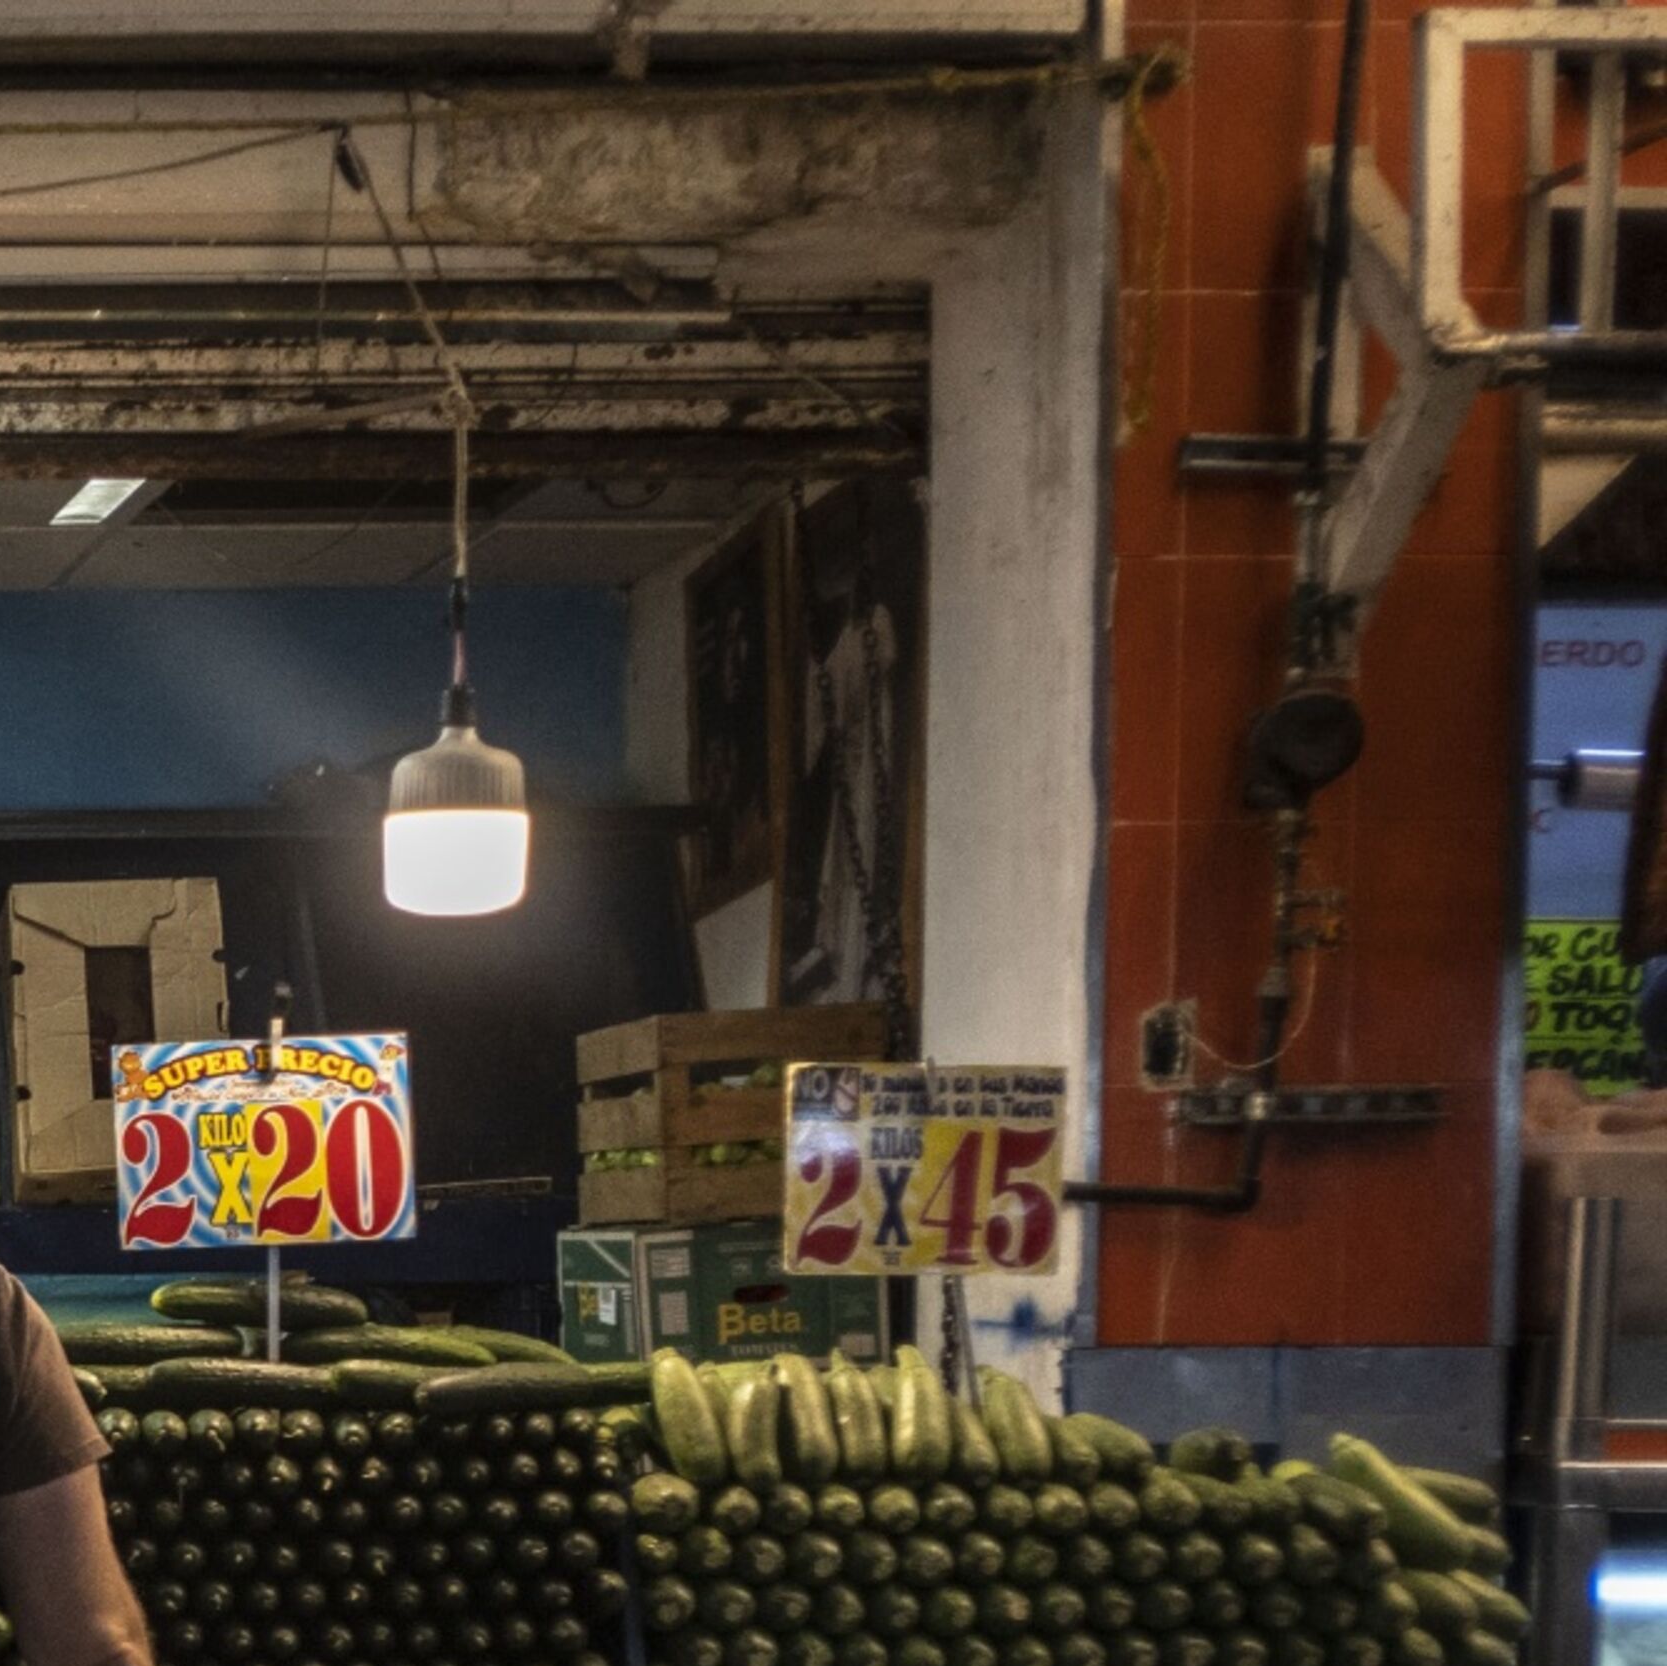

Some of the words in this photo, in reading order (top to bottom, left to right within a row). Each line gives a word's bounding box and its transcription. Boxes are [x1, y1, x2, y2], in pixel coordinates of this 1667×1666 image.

[1540, 640, 1646, 667] ERDO
[142, 1046, 250, 1101] SUPER
[122, 1112, 197, 1246] 2
[208, 1150, 254, 1227] X
[251, 1099, 405, 1240] 20
[792, 1130, 862, 1268] 2
[873, 1166, 913, 1246] X
[919, 1127, 1057, 1269] 45
[718, 1303, 802, 1345] Beta
